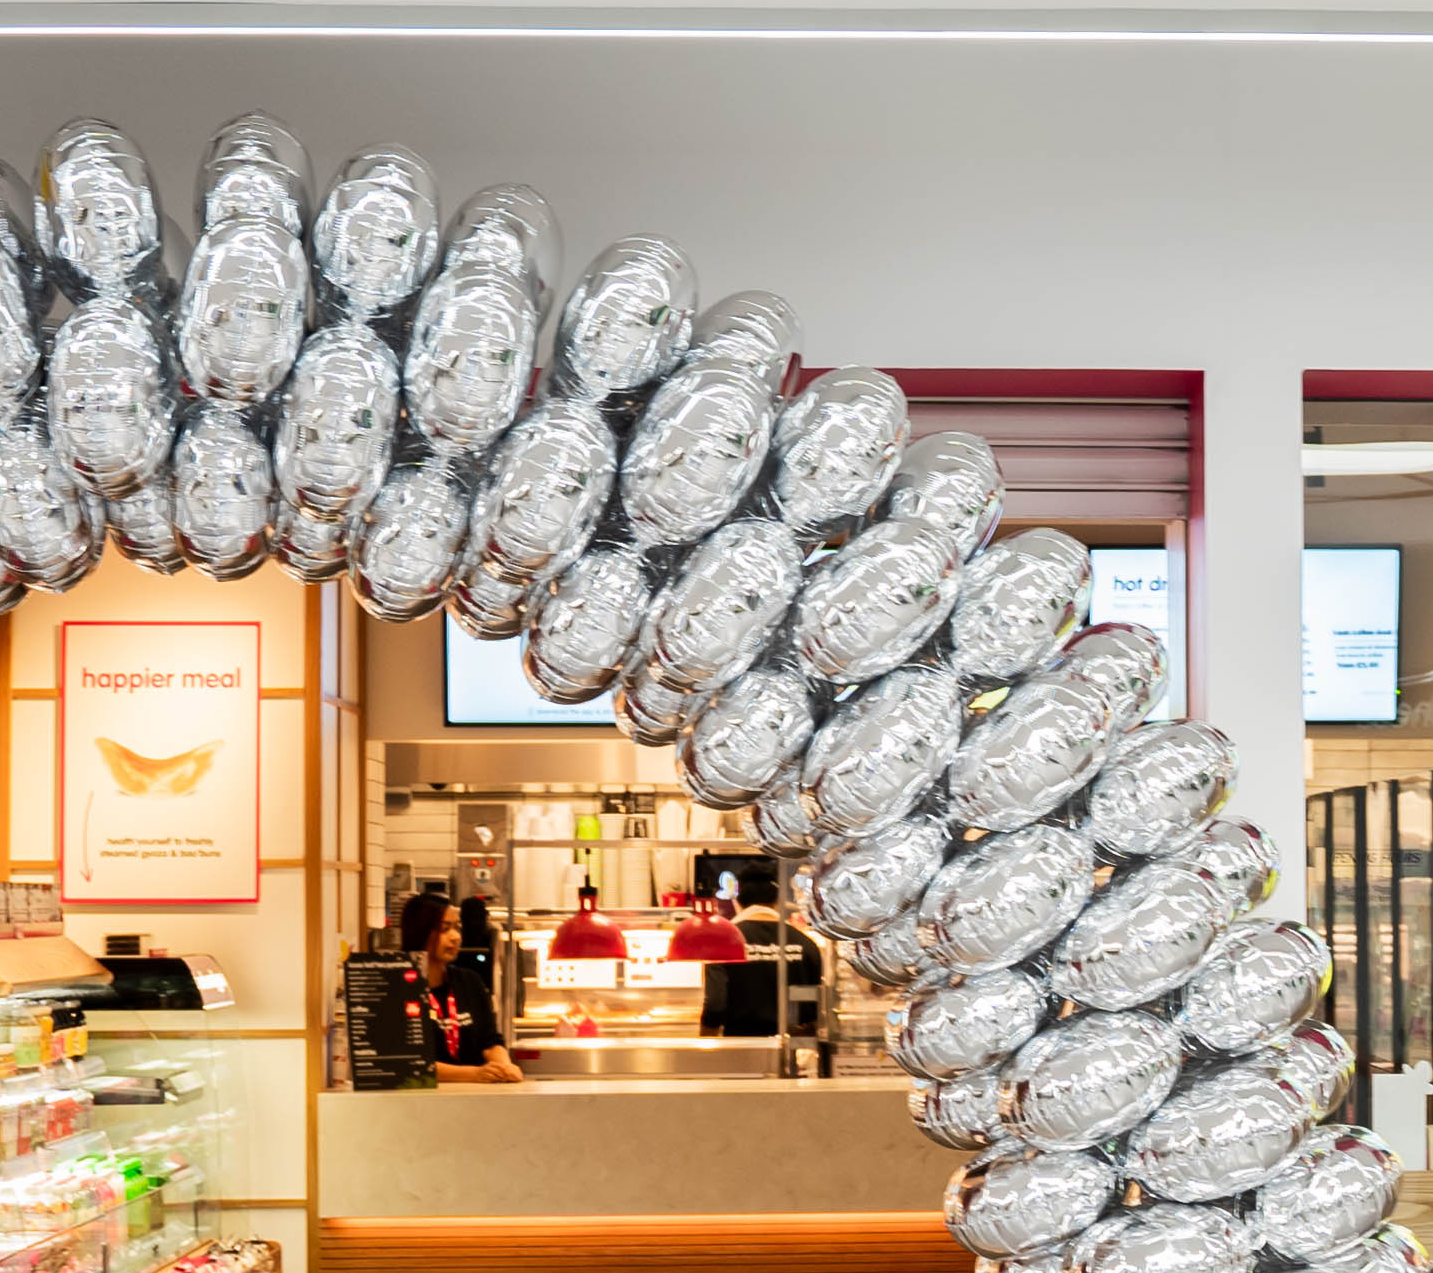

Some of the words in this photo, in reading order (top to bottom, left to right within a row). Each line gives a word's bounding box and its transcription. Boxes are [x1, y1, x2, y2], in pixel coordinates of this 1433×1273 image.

[1114, 577, 1144, 591] hot
[82, 667, 175, 694] happier
[182, 667, 241, 689] meal
